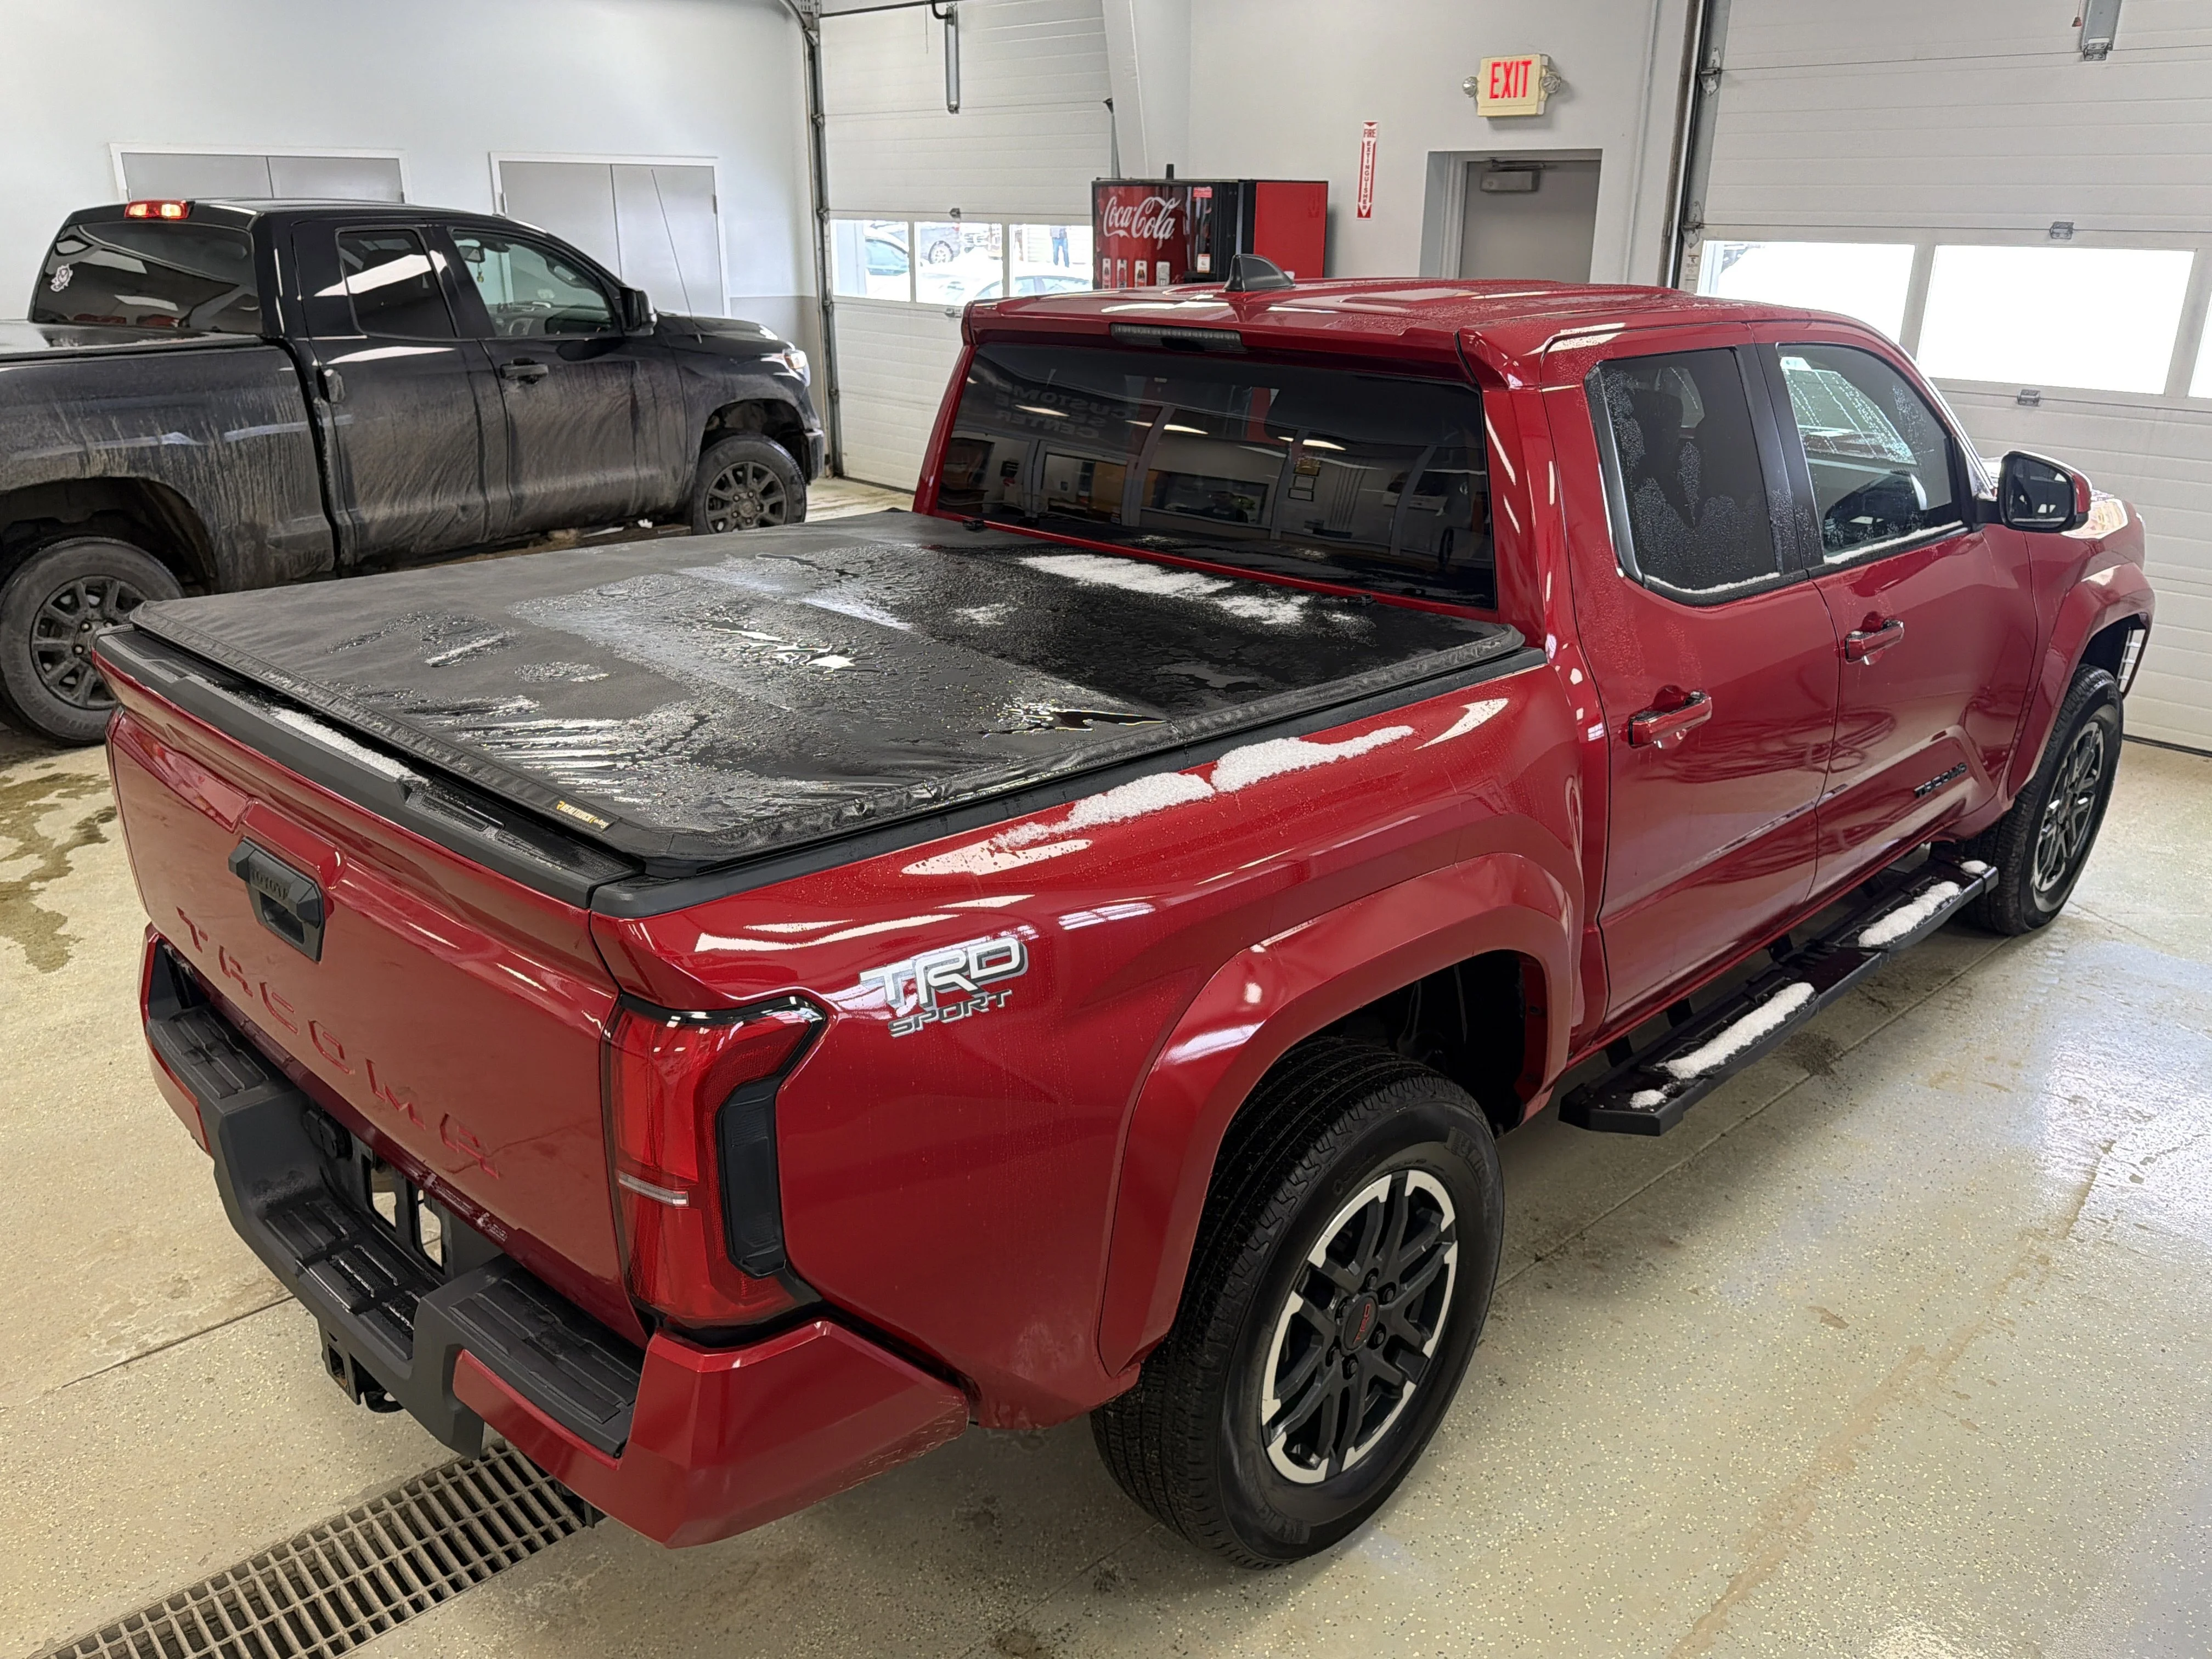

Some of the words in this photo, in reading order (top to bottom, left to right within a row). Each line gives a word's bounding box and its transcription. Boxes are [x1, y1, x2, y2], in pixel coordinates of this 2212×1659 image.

[1489, 59, 1532, 99] EXIT
[1363, 128, 1376, 138] FIRE
[1362, 140, 1372, 210] EXTINGUISHER
[1103, 196, 1181, 240] Coca-Cola
[859, 936, 1029, 1010] TRD
[888, 989, 1013, 1038] SPORT
[176, 906, 501, 1180] TACOMA
[1353, 1303, 1372, 1346] TRD
